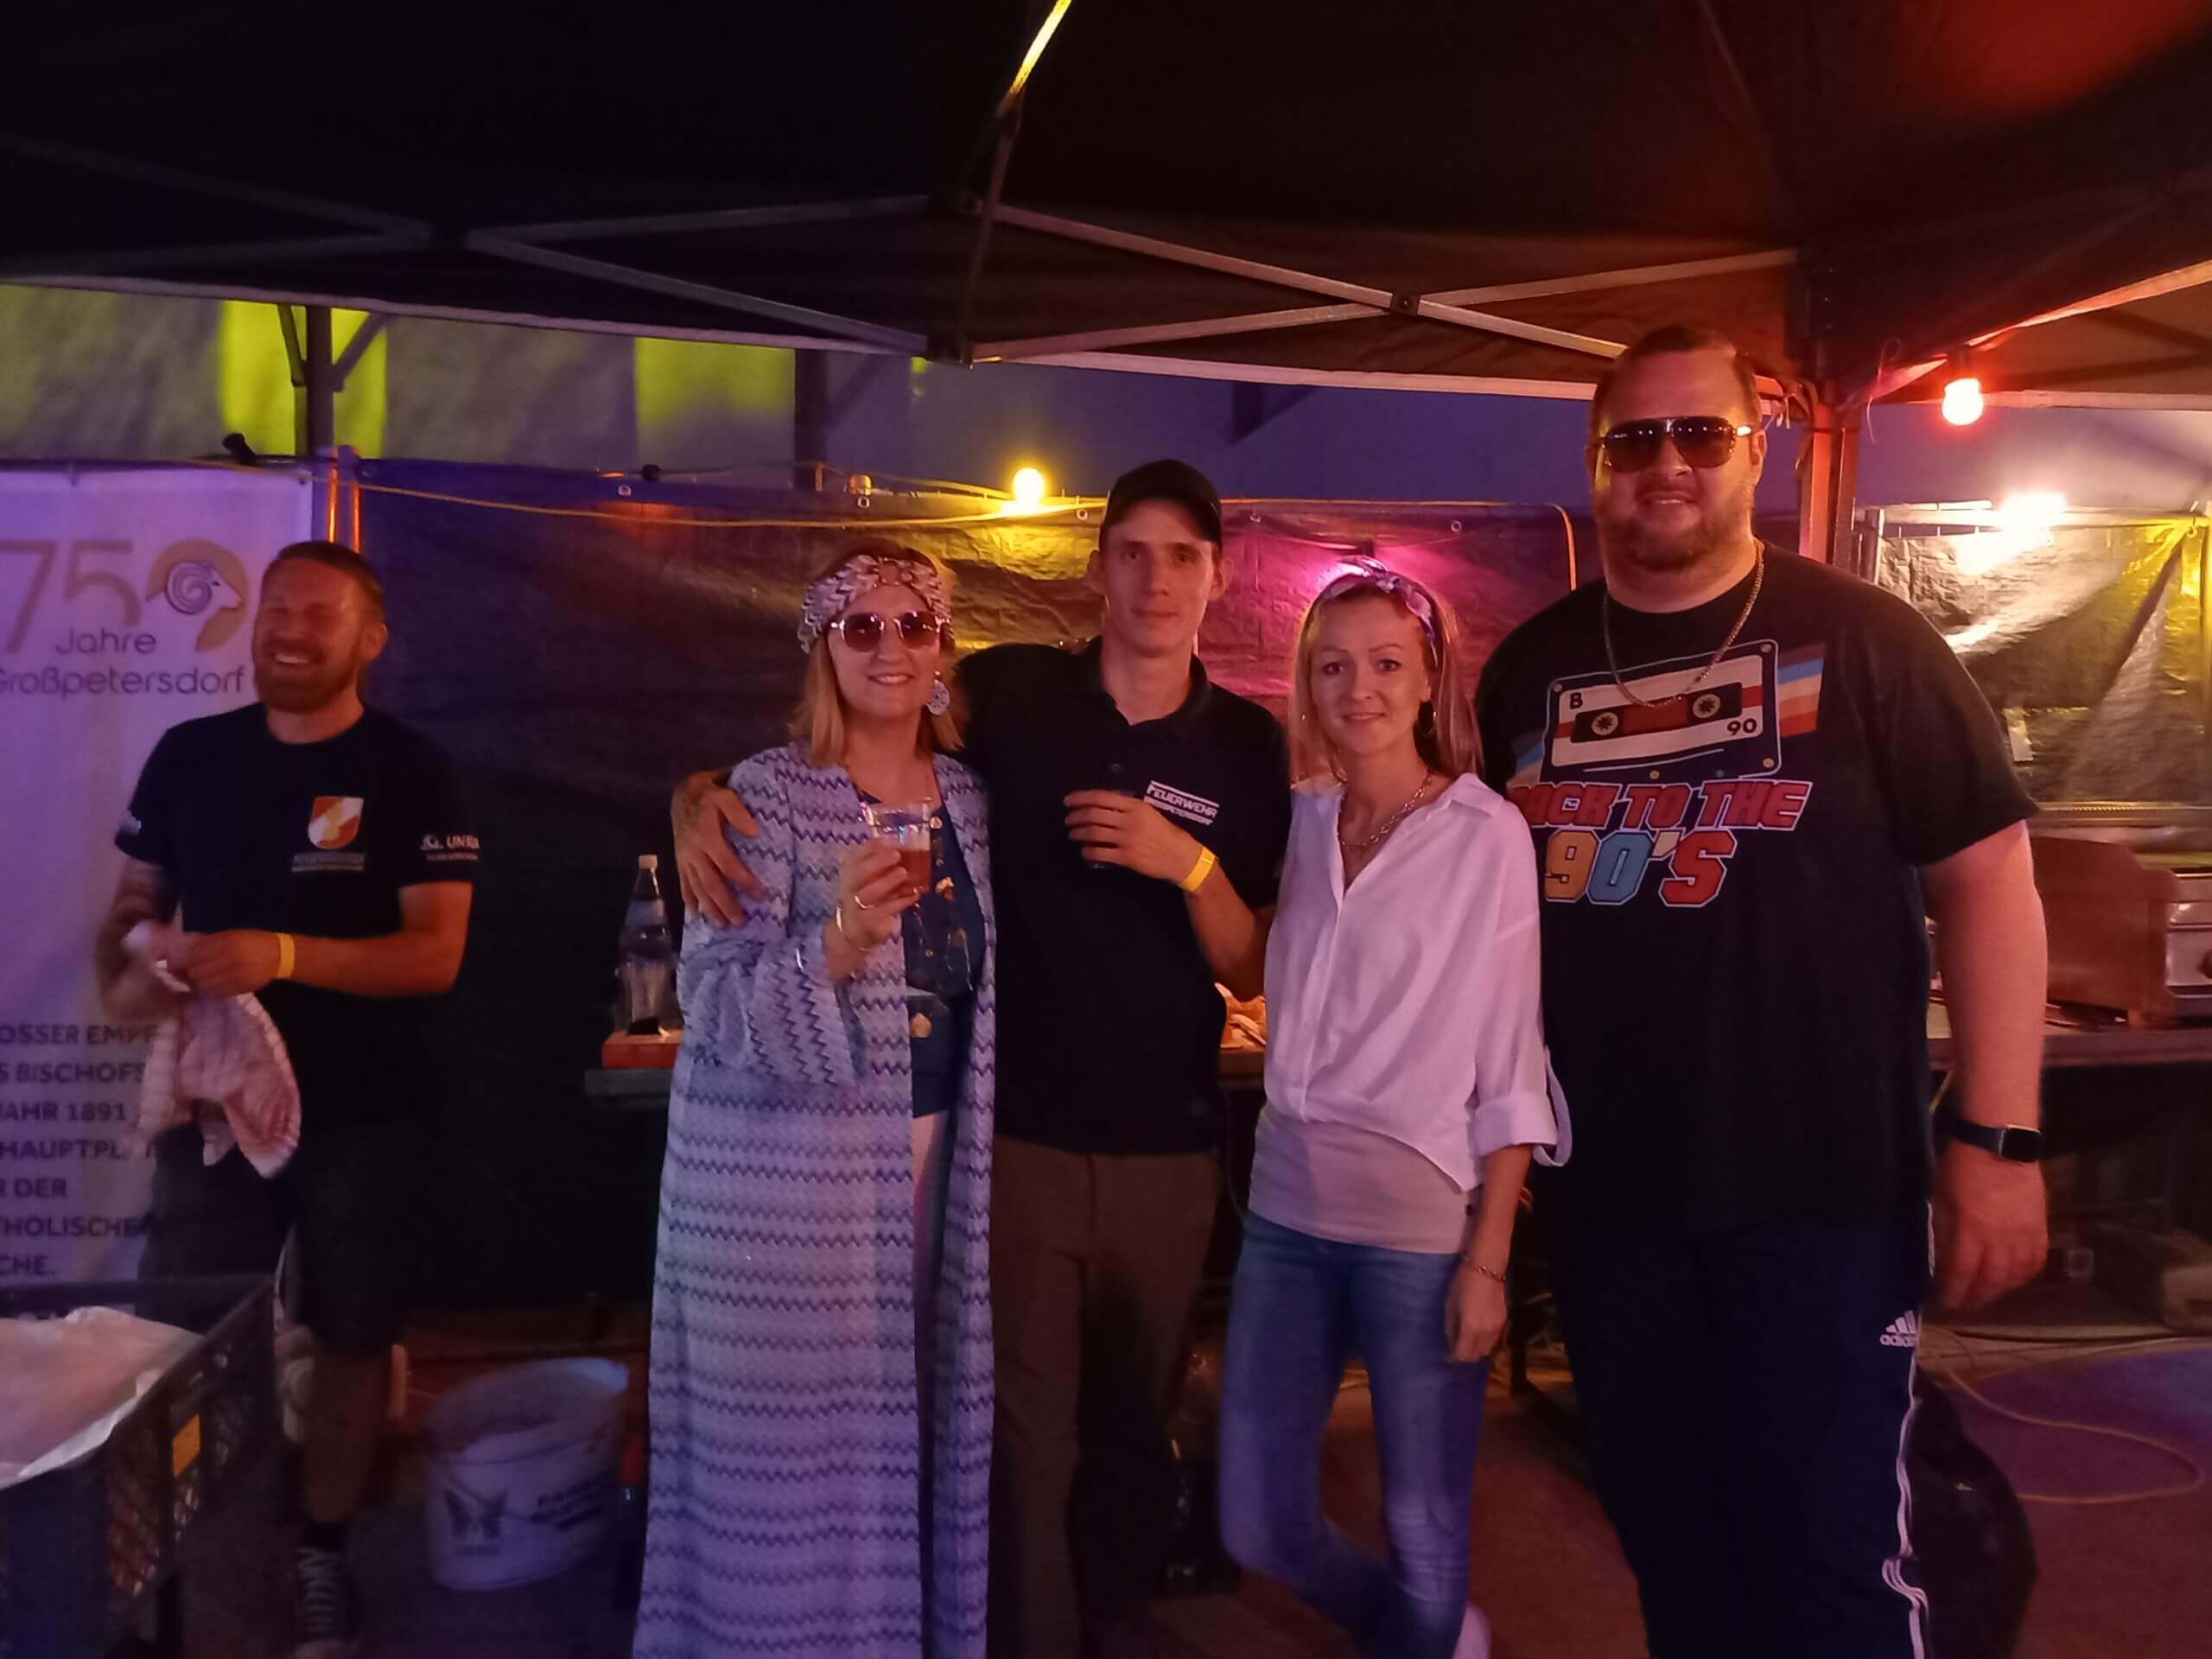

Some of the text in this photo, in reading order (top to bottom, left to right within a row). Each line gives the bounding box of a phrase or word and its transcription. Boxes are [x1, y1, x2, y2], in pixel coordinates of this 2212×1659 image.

[55, 627, 156, 654] Jahre
[1569, 691, 1585, 709] B
[1726, 717, 1759, 736] 90
[1147, 784, 1218, 818] FEUERWEHR
[1621, 782, 1694, 830] TO
[1696, 779, 1813, 830] THE
[1544, 829, 1738, 907] 90'S
[0, 1102, 127, 1122] AHR 1891
[0, 1139, 150, 1160] HAUPTPL
[15, 1178, 68, 1199] DER
[0, 1216, 143, 1237] HOLISCHE
